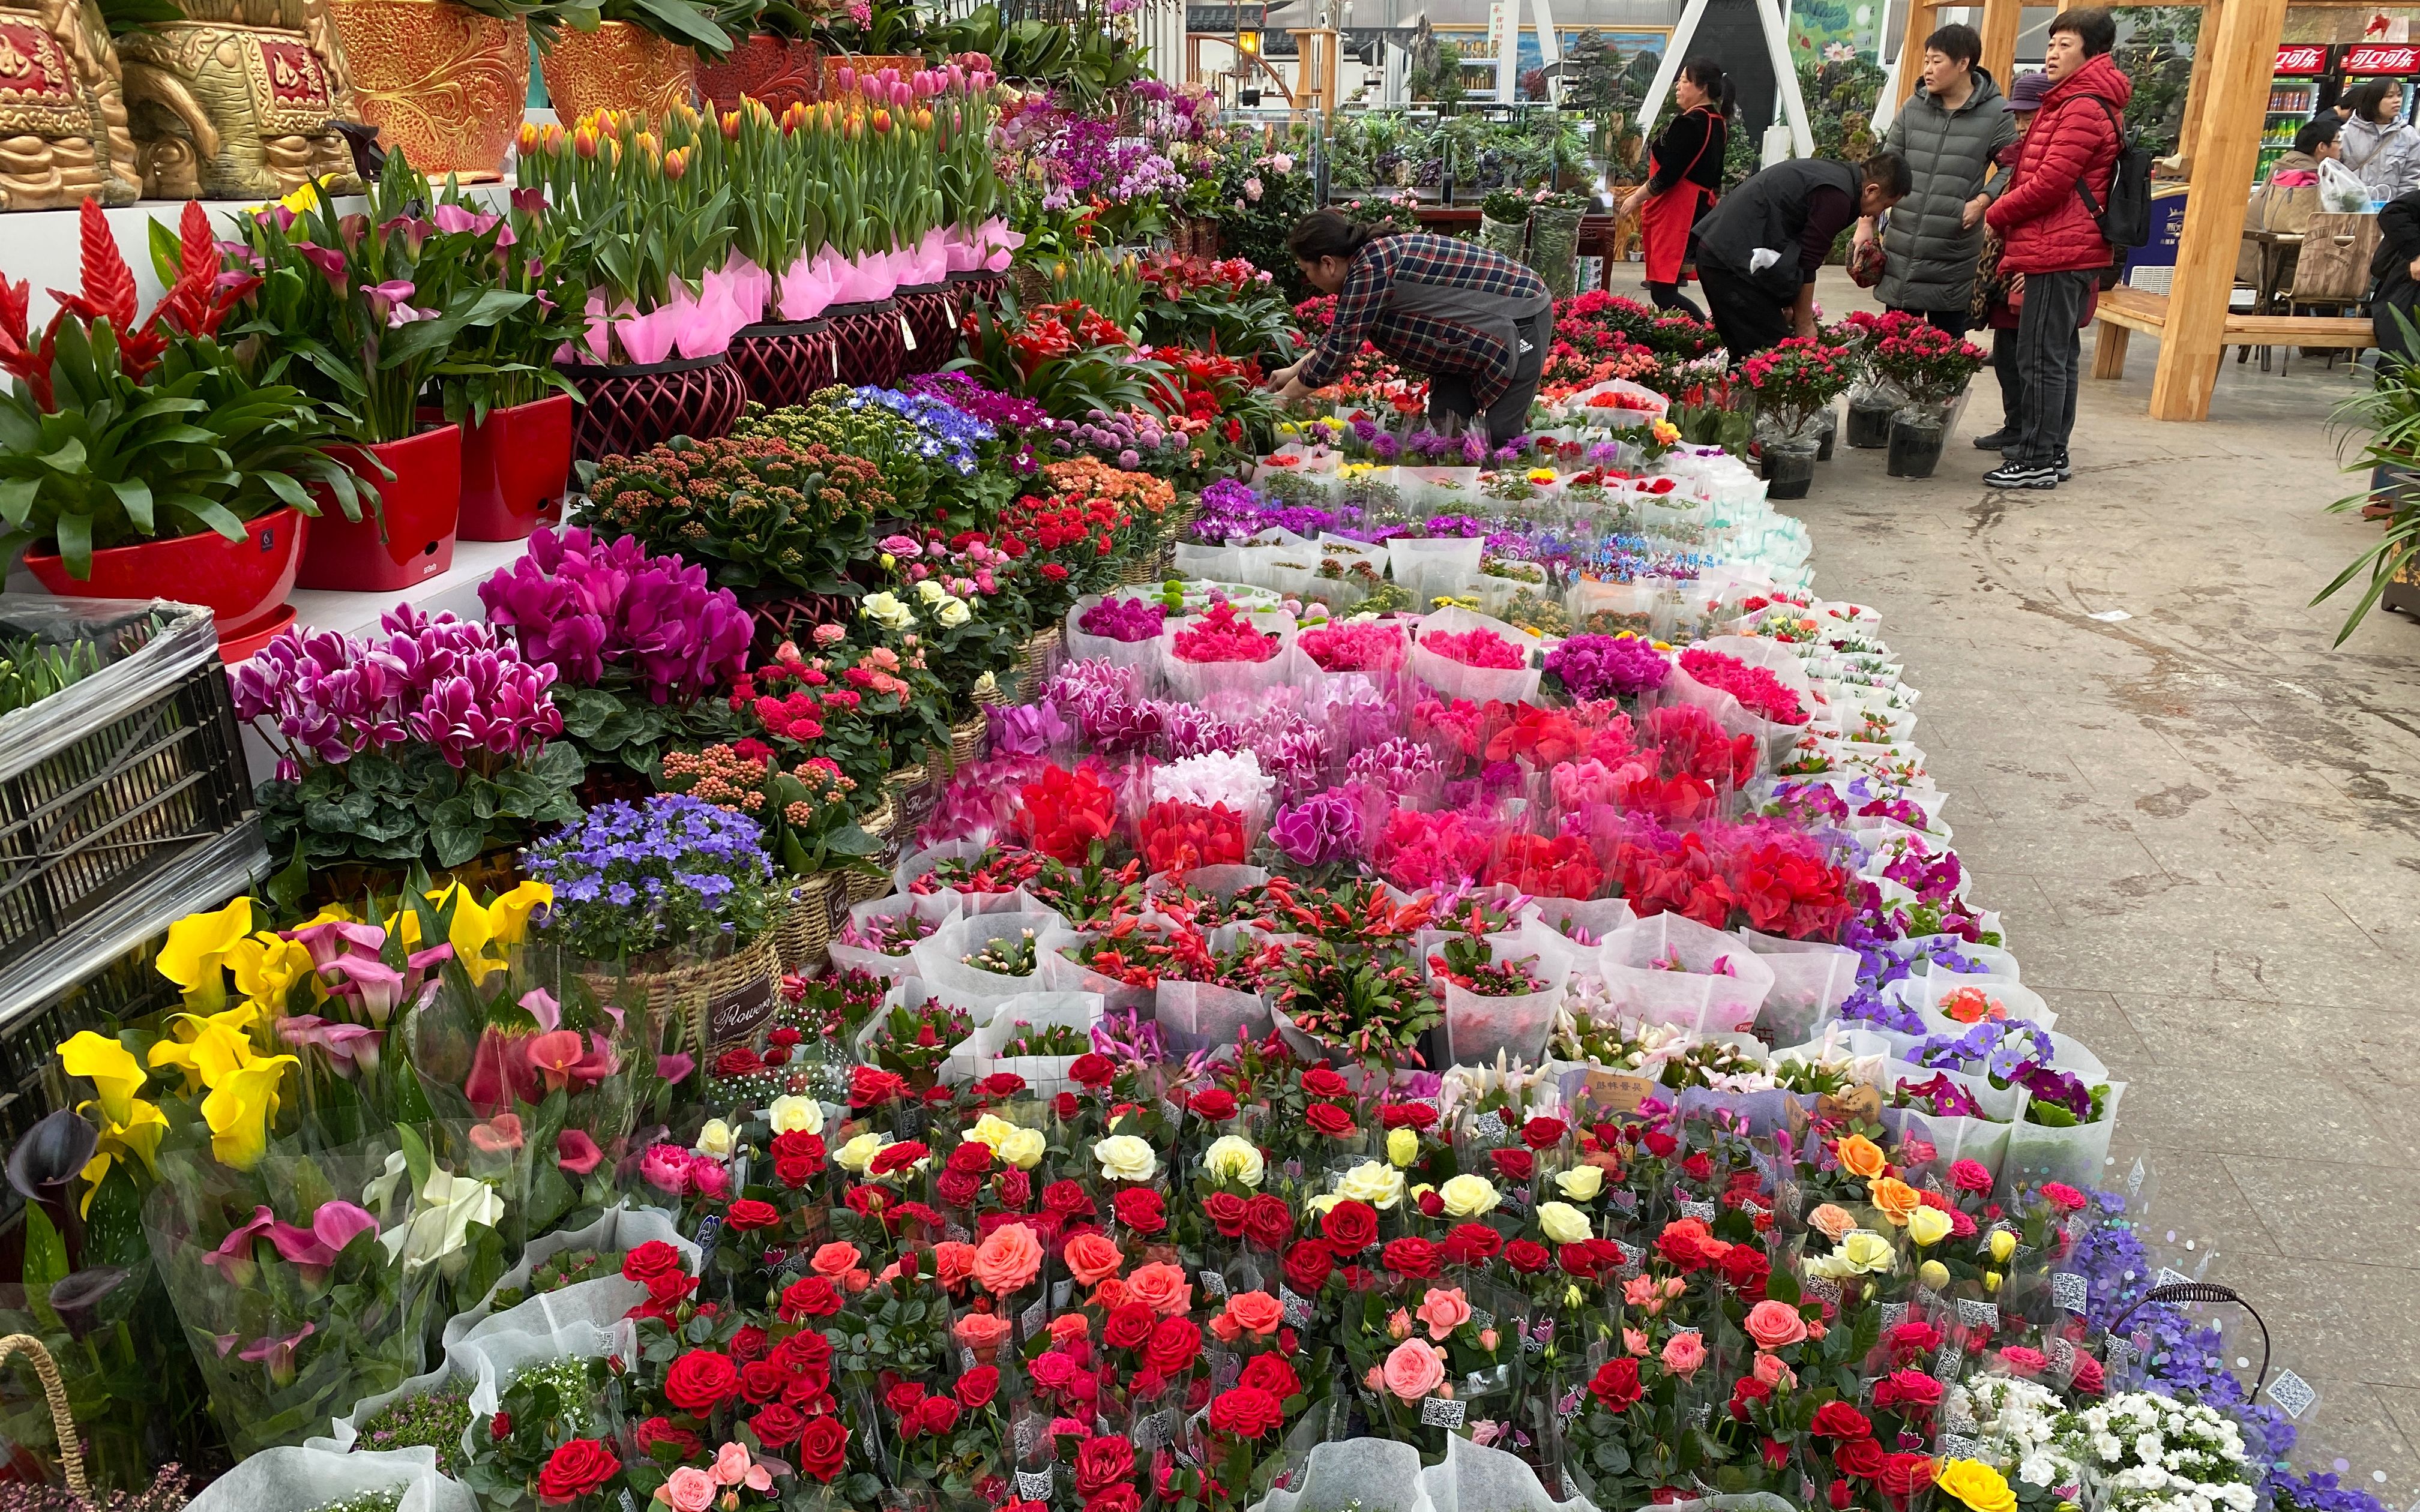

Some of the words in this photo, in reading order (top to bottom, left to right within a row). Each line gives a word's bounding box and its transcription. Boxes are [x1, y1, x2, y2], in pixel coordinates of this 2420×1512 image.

[2275, 48, 2325, 69] 口可乐
[2350, 48, 2420, 68] 可口可乐
[714, 998, 771, 1032] Flowers
